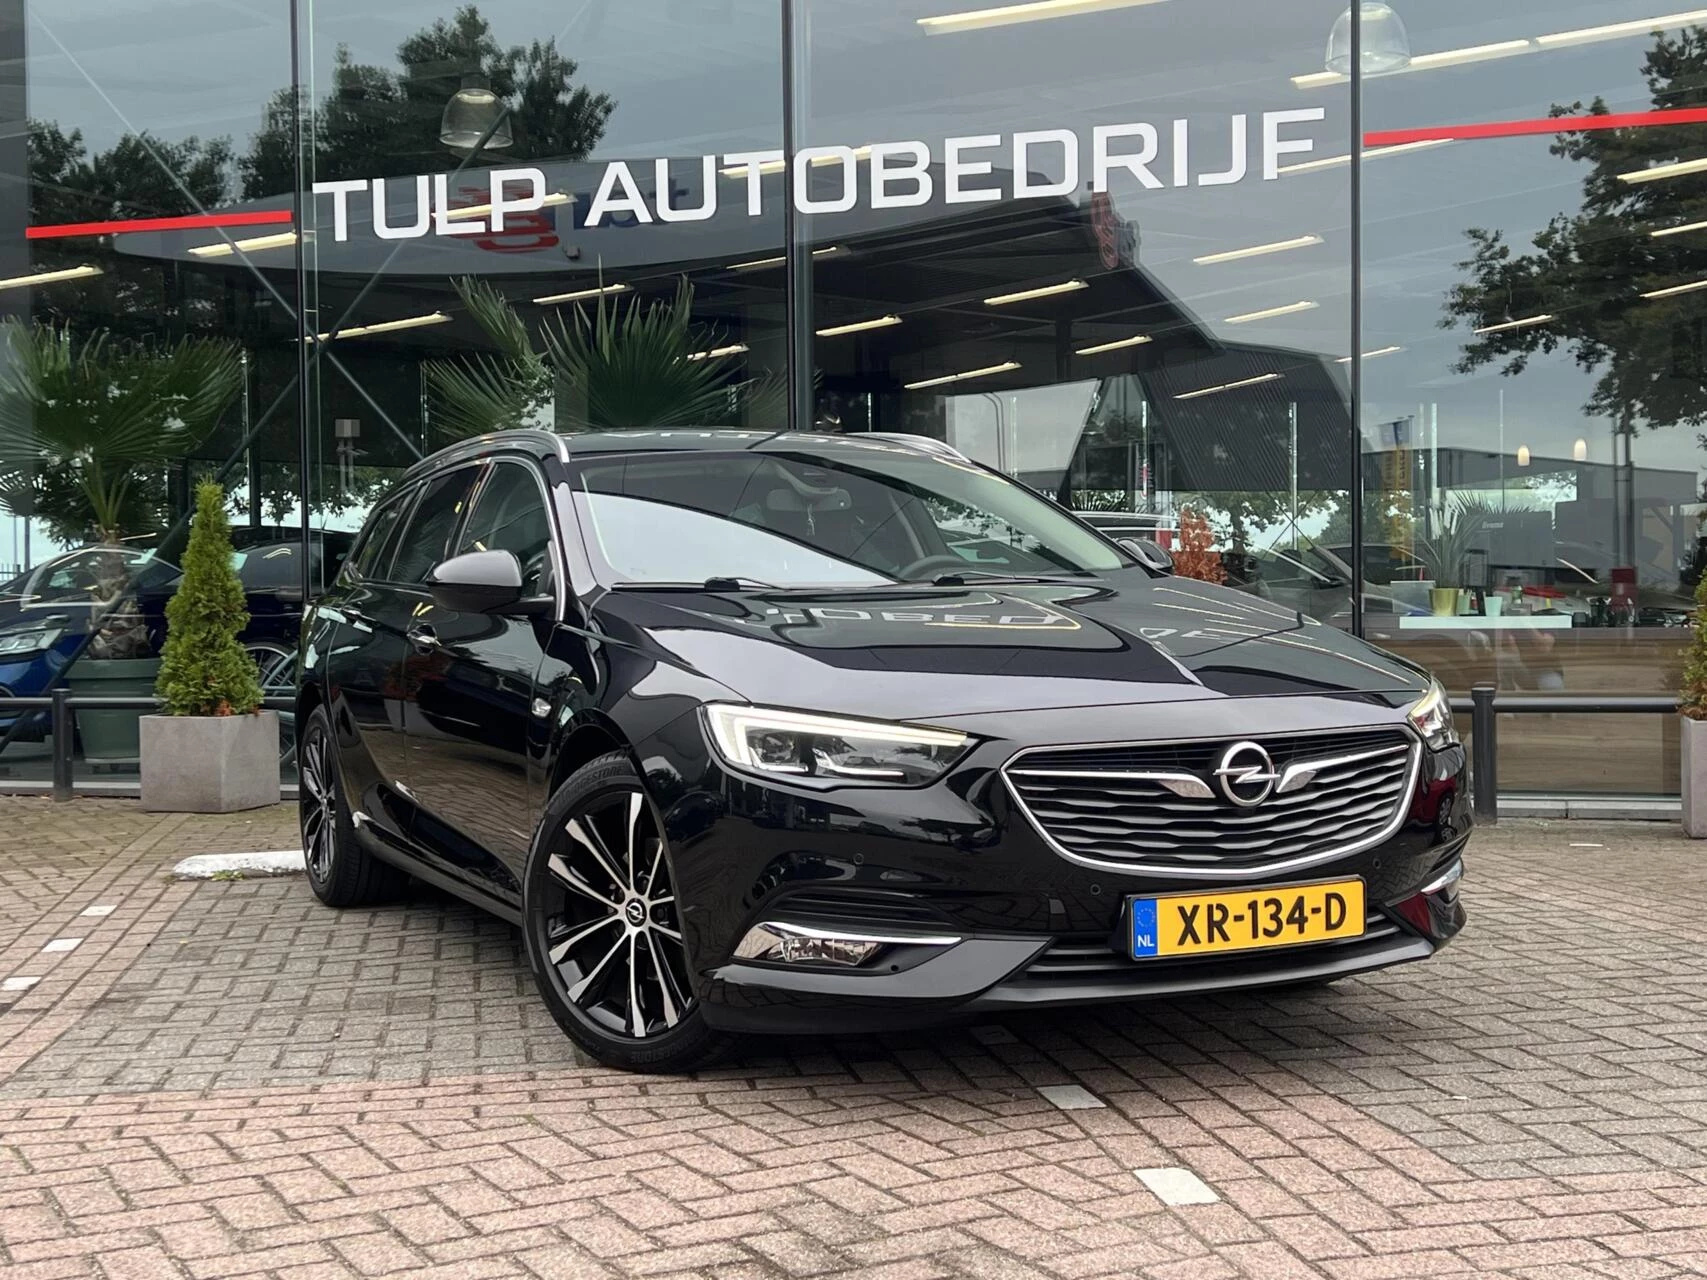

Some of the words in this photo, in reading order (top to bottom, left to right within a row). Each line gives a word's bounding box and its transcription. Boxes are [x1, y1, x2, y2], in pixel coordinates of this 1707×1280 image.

[312, 168, 547, 242] TULP
[584, 107, 1326, 227] AUTOBEDRIJF
[1137, 934, 1155, 948] NL
[1177, 892, 1348, 947] XR-134-D
